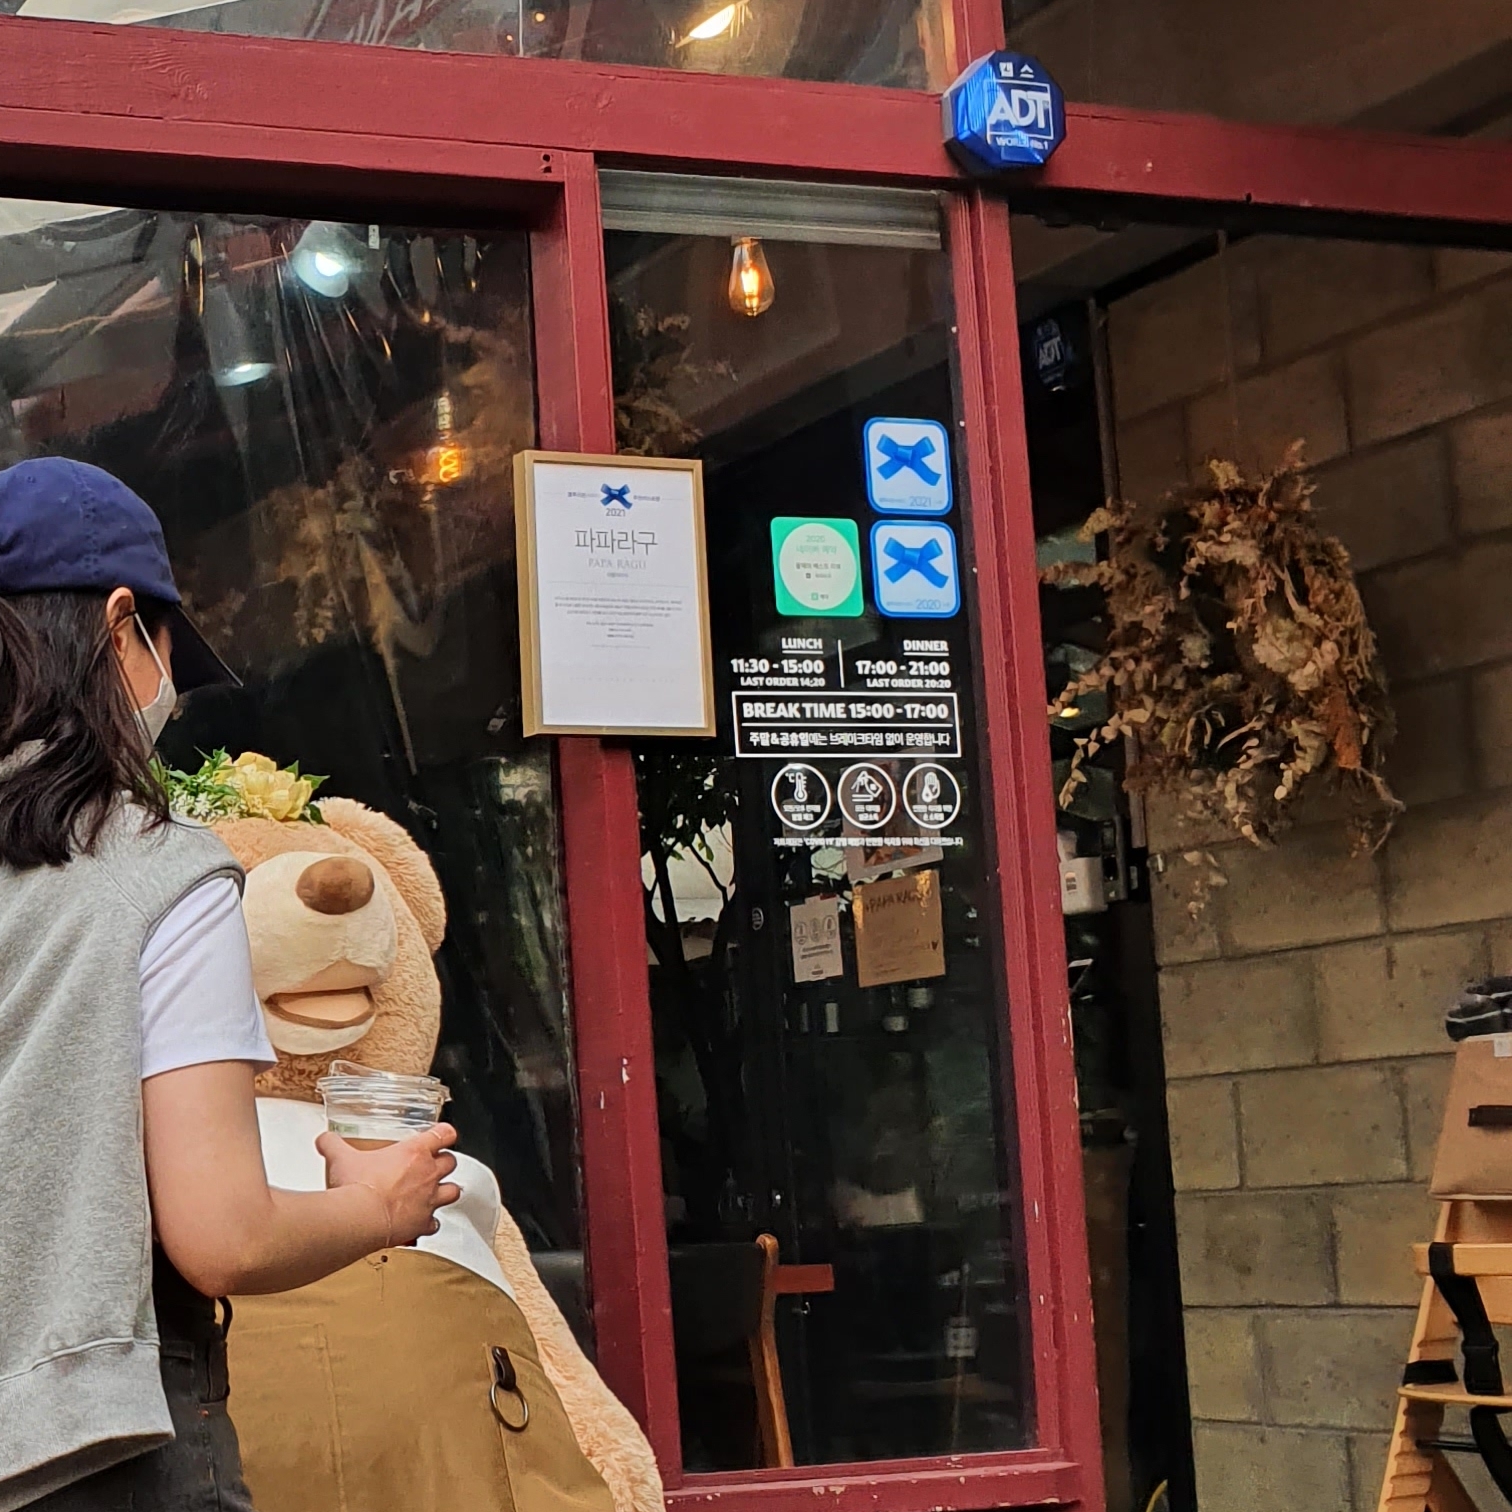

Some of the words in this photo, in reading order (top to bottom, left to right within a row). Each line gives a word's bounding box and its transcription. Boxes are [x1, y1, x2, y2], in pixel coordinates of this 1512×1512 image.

[988, 89, 1050, 128] ADT
[606, 508, 626, 518] 2021
[575, 528, 658, 555] 파파라구
[782, 638, 822, 650] LUNCH
[903, 640, 949, 652] DINNER
[730, 658, 770, 674] 11:30
[781, 659, 824, 674] 15:00
[856, 660, 897, 674] 17:00
[908, 661, 950, 676] 21:00
[740, 676, 765, 687] LAST
[766, 677, 799, 687] ORDER
[866, 678, 890, 688] LAST
[891, 679, 924, 688] ORDER
[924, 679, 952, 689] 20:20
[742, 702, 801, 718] BREAK
[801, 702, 847, 718] TIME
[830, 732, 884, 746] 브레이크타임
[886, 732, 904, 746] 없이
[906, 732, 950, 746] 운영합니다
